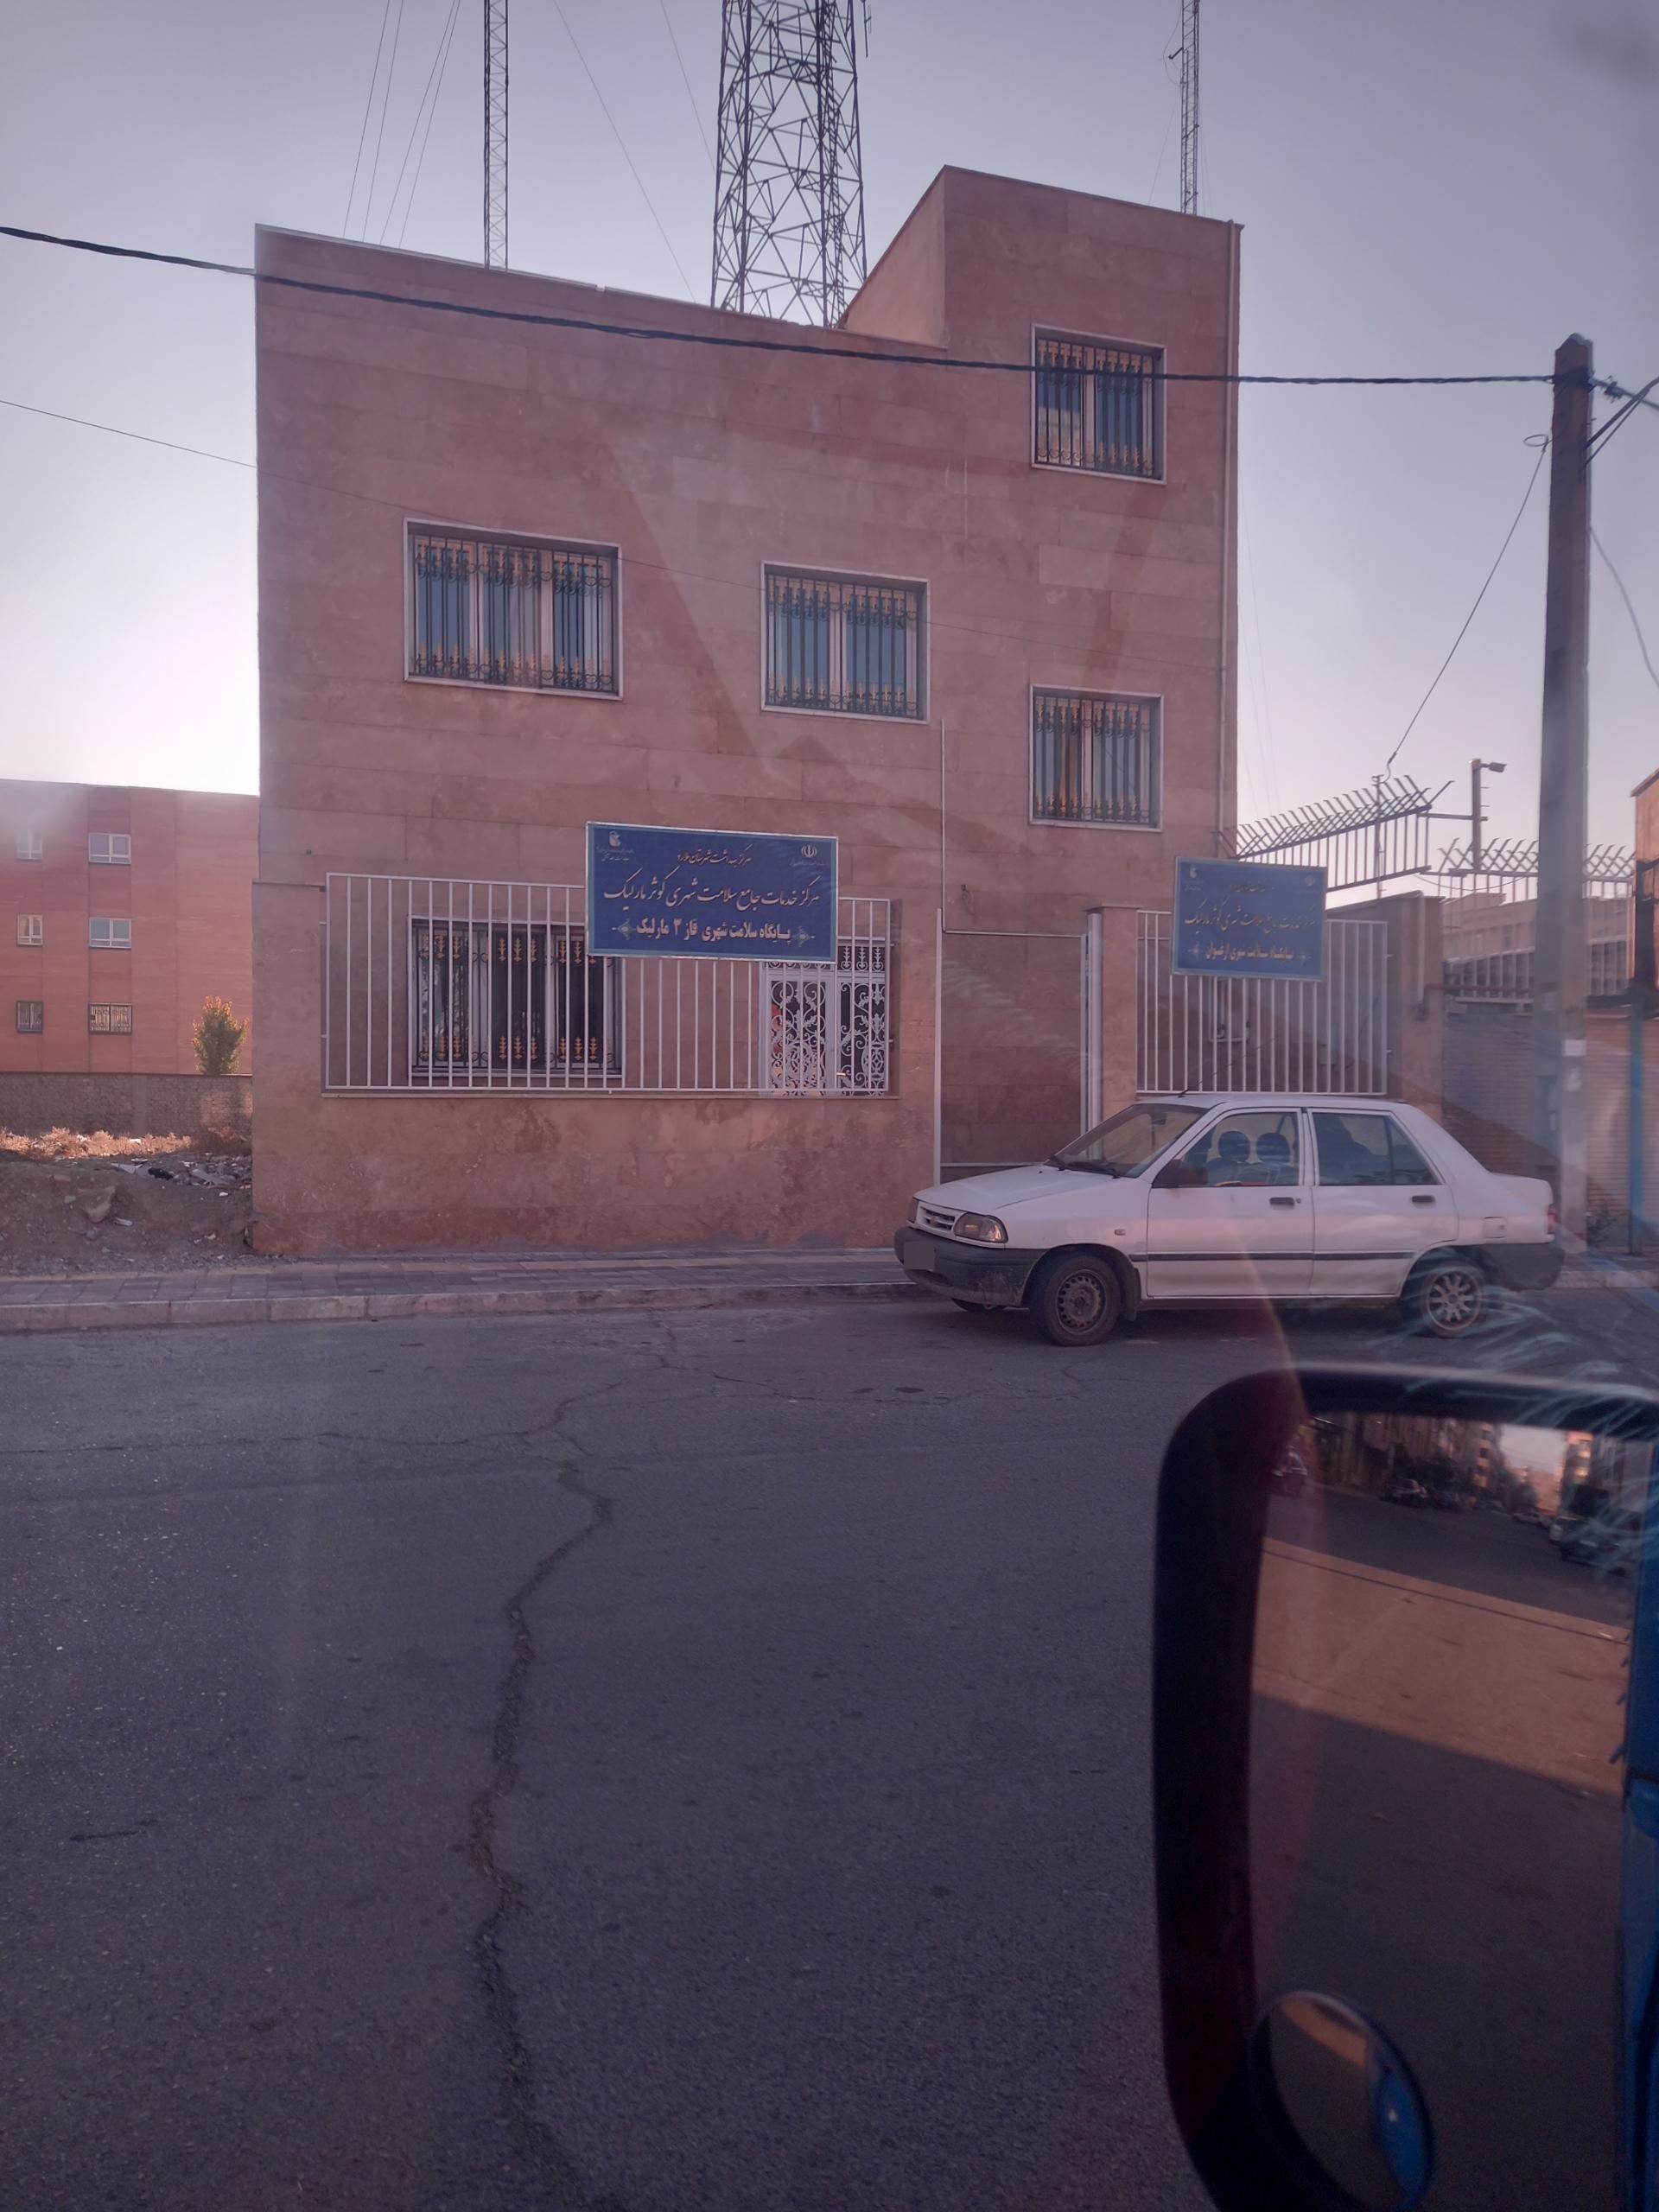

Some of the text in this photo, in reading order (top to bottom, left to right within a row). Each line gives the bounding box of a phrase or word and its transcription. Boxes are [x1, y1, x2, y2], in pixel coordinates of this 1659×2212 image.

[603, 865, 821, 911] مرکز خدمات جامع سلامت شهری کوثر مارلیک
[636, 918, 791, 944] پایگاه سلامت شهری فاز ۳ مارلیک
